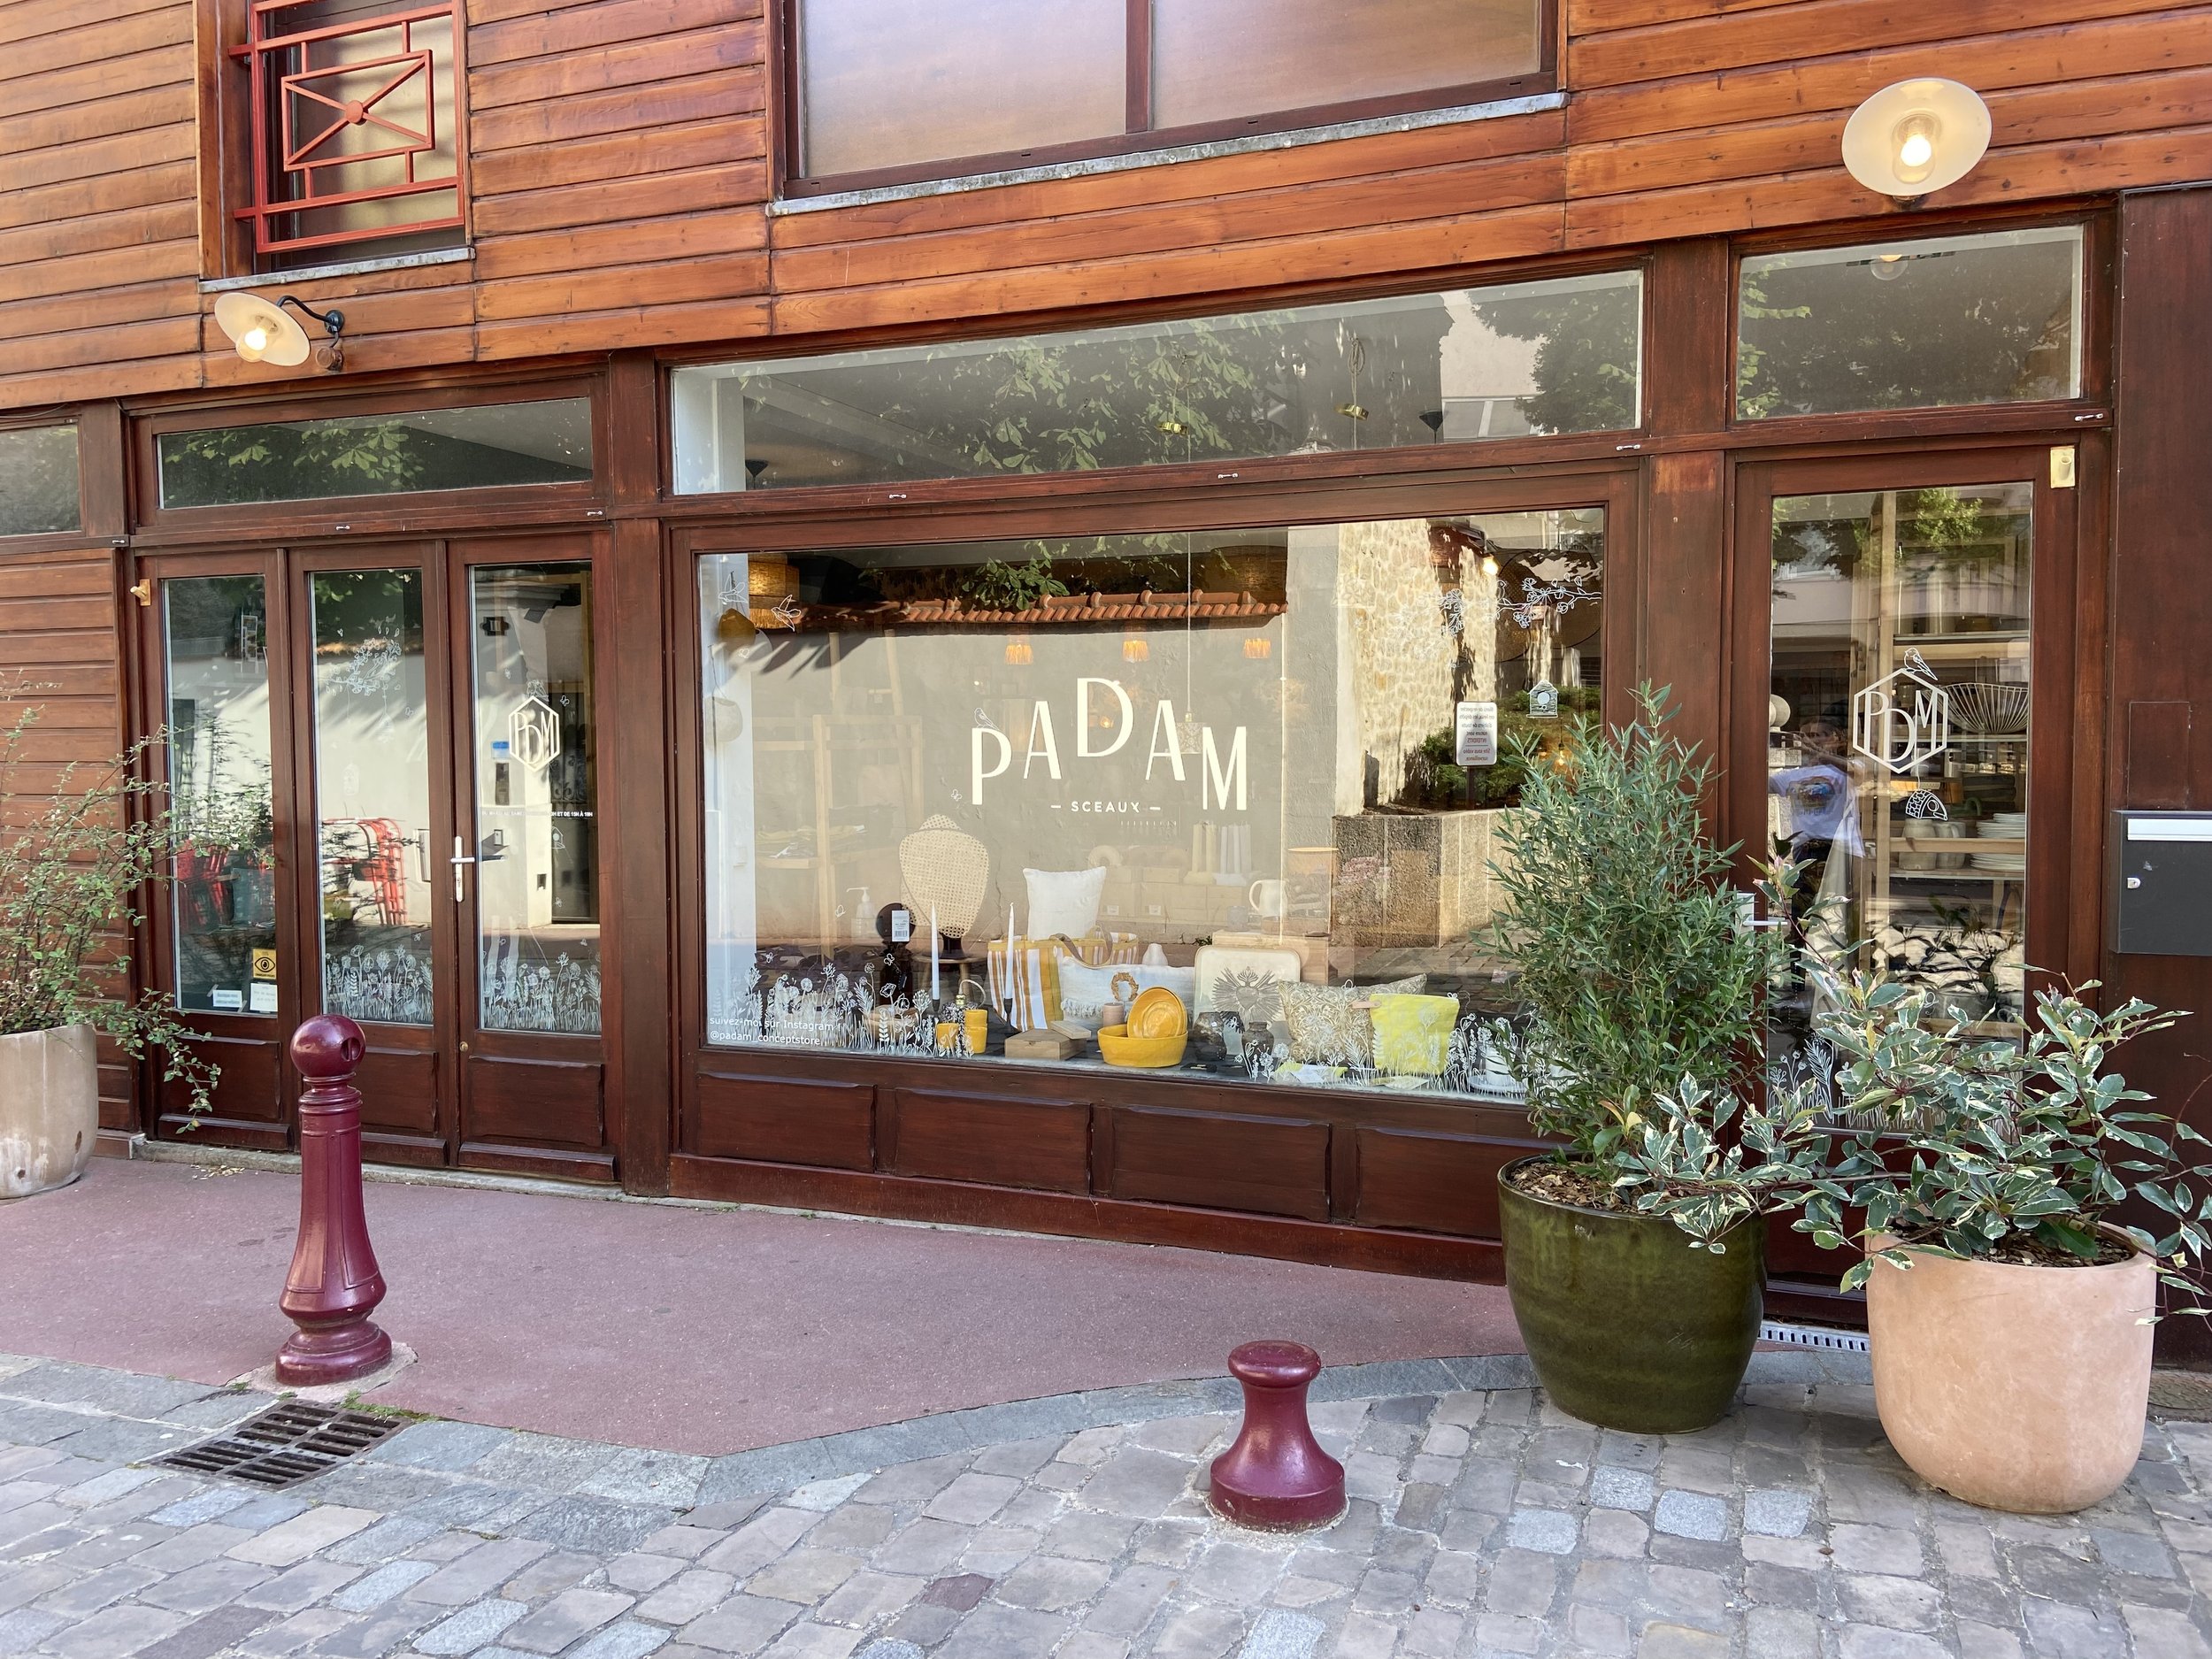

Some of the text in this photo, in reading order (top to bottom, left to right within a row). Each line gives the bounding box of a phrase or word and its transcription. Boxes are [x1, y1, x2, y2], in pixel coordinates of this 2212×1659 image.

[972, 678, 1247, 810] PADAM
[1071, 800, 1141, 813] SCEAUX
[764, 1019, 780, 1028] sur
[784, 1019, 833, 1031] Instagram
[710, 1030, 820, 1045] @padam_conceptstore
